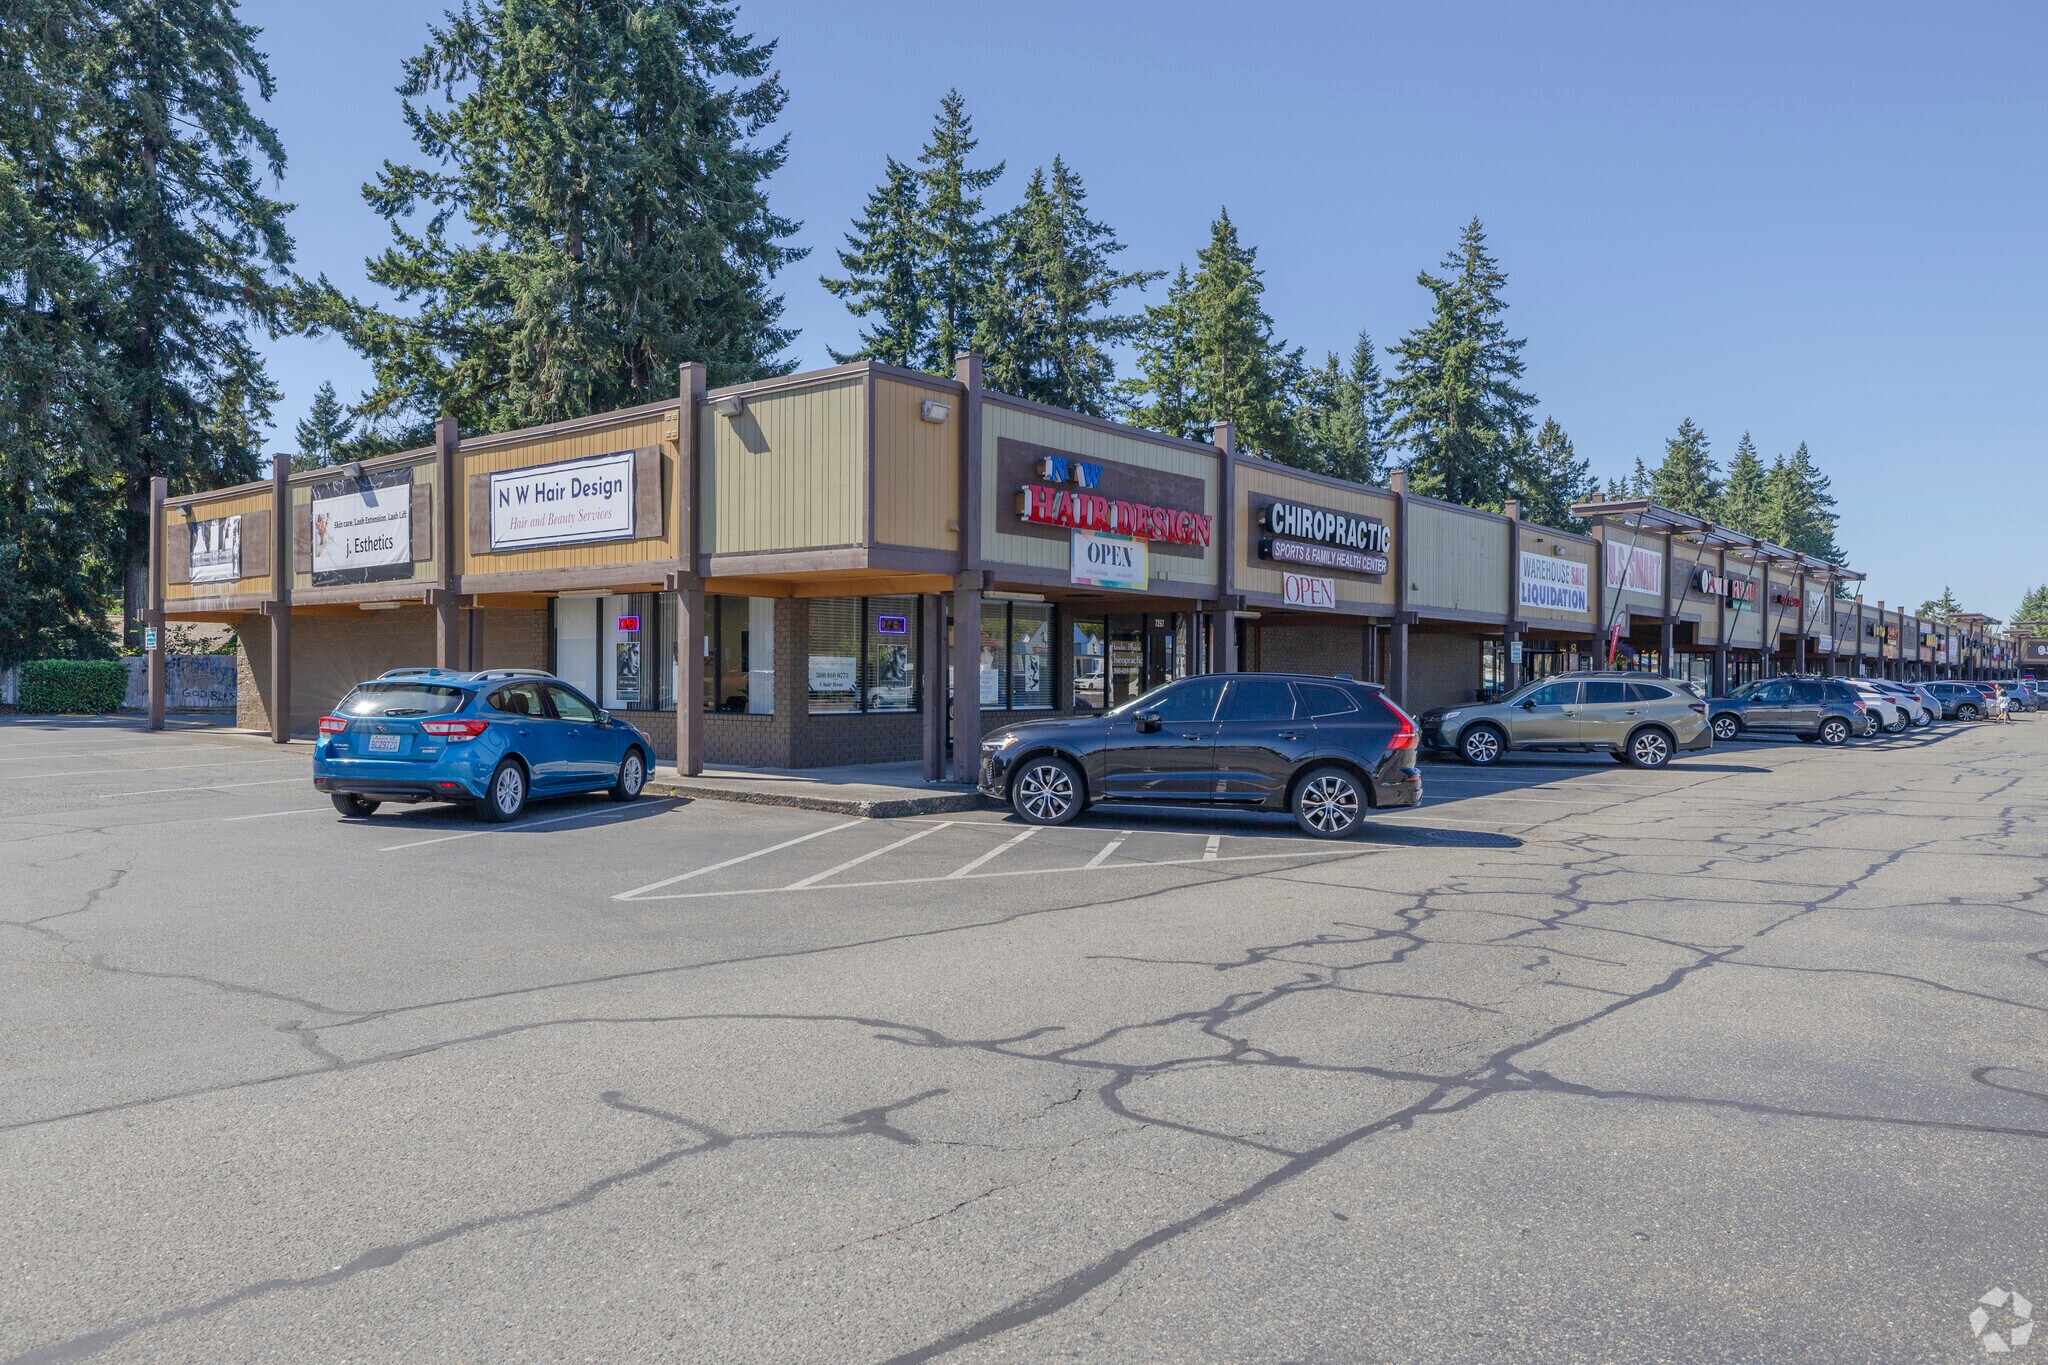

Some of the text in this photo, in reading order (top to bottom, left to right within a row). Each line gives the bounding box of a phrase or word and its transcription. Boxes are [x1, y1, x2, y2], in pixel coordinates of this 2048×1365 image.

[1043, 455, 1104, 488] N W
[499, 476, 623, 508] N W Hair Design
[354, 517, 365, 526] Lash
[388, 511, 398, 520] Lash
[510, 508, 613, 530] Hair and Beauty Services
[1021, 485, 1213, 547] HAIR DESIGN
[1271, 502, 1391, 553] CHIROPRACTIC
[354, 534, 394, 553] Esthetics
[1087, 541, 1134, 568] OPEN
[1275, 542, 1387, 573] SPORTS & FAMILY HEALTH CENTER
[1523, 556, 1585, 587] WAREHOUSE SALE
[1629, 550, 1661, 592] SMART
[1285, 575, 1333, 605] OPEN
[1521, 582, 1586, 610] LIQUIDATION
[620, 618, 638, 630] OPEN
[1110, 653, 1143, 666] Chiropractic
[182, 688, 208, 698] GOD
